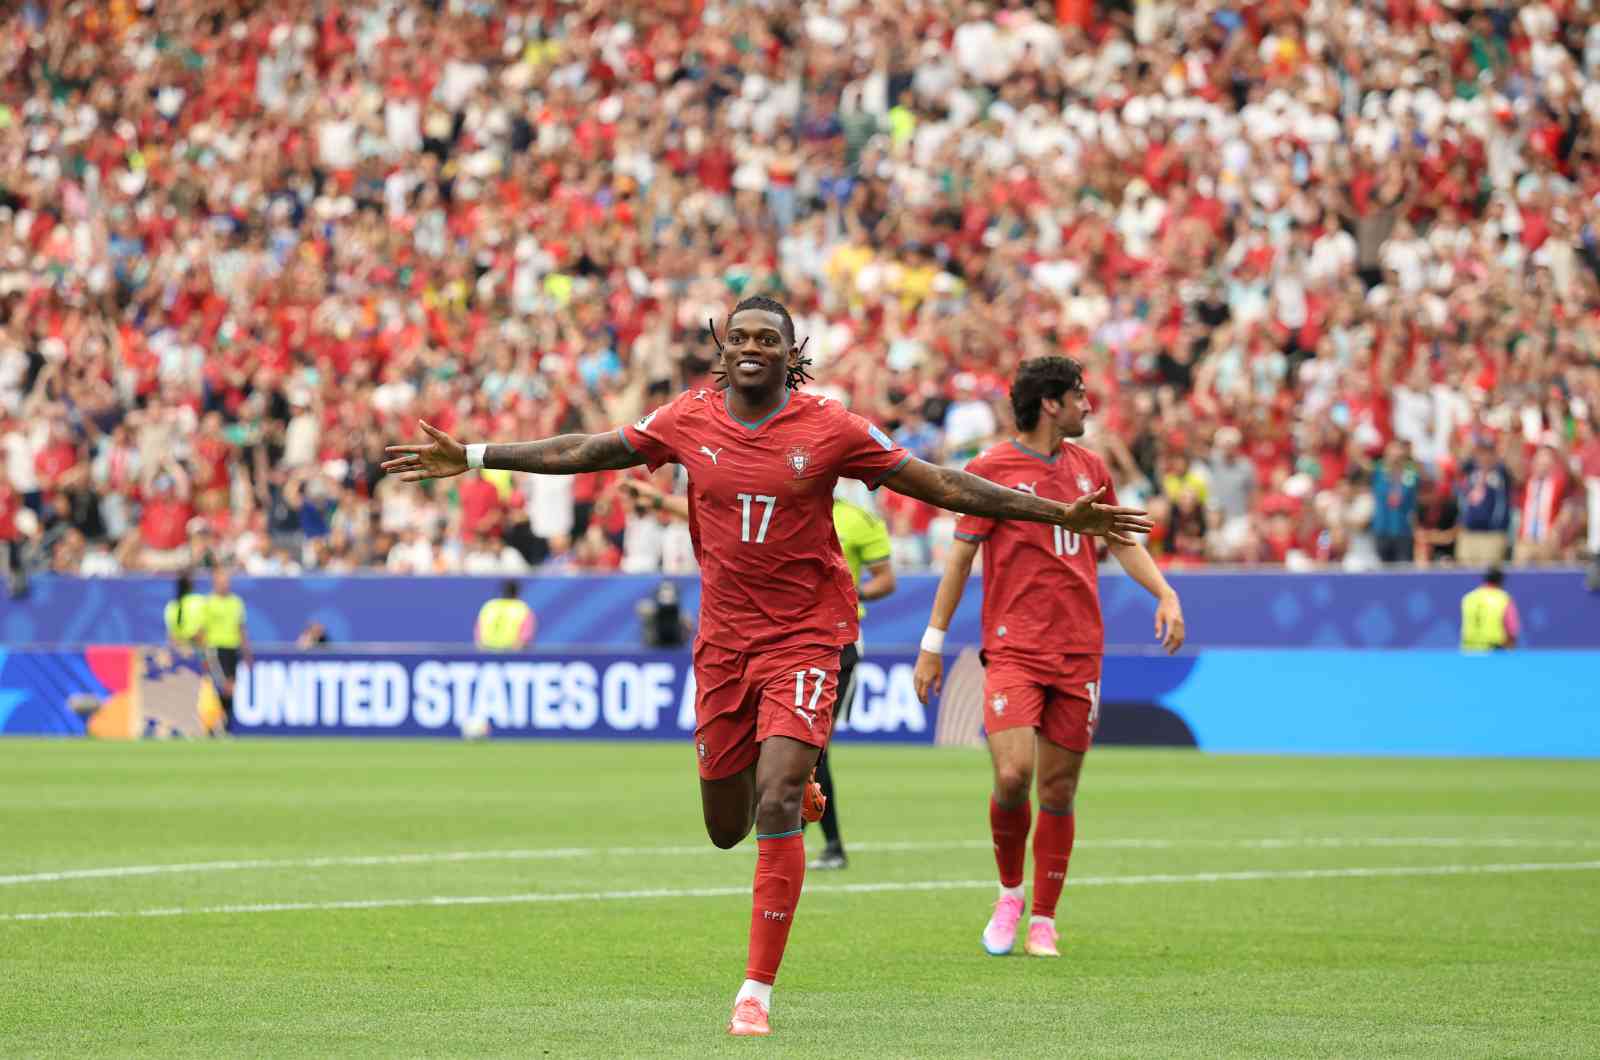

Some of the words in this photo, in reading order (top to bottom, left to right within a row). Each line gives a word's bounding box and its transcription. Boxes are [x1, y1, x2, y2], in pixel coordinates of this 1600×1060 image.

[736, 493, 776, 544] 17
[1053, 524, 1081, 557] 10
[233, 661, 409, 728] UNITED
[412, 661, 599, 729] STATES
[603, 661, 676, 730] OF
[793, 667, 826, 711] 17
